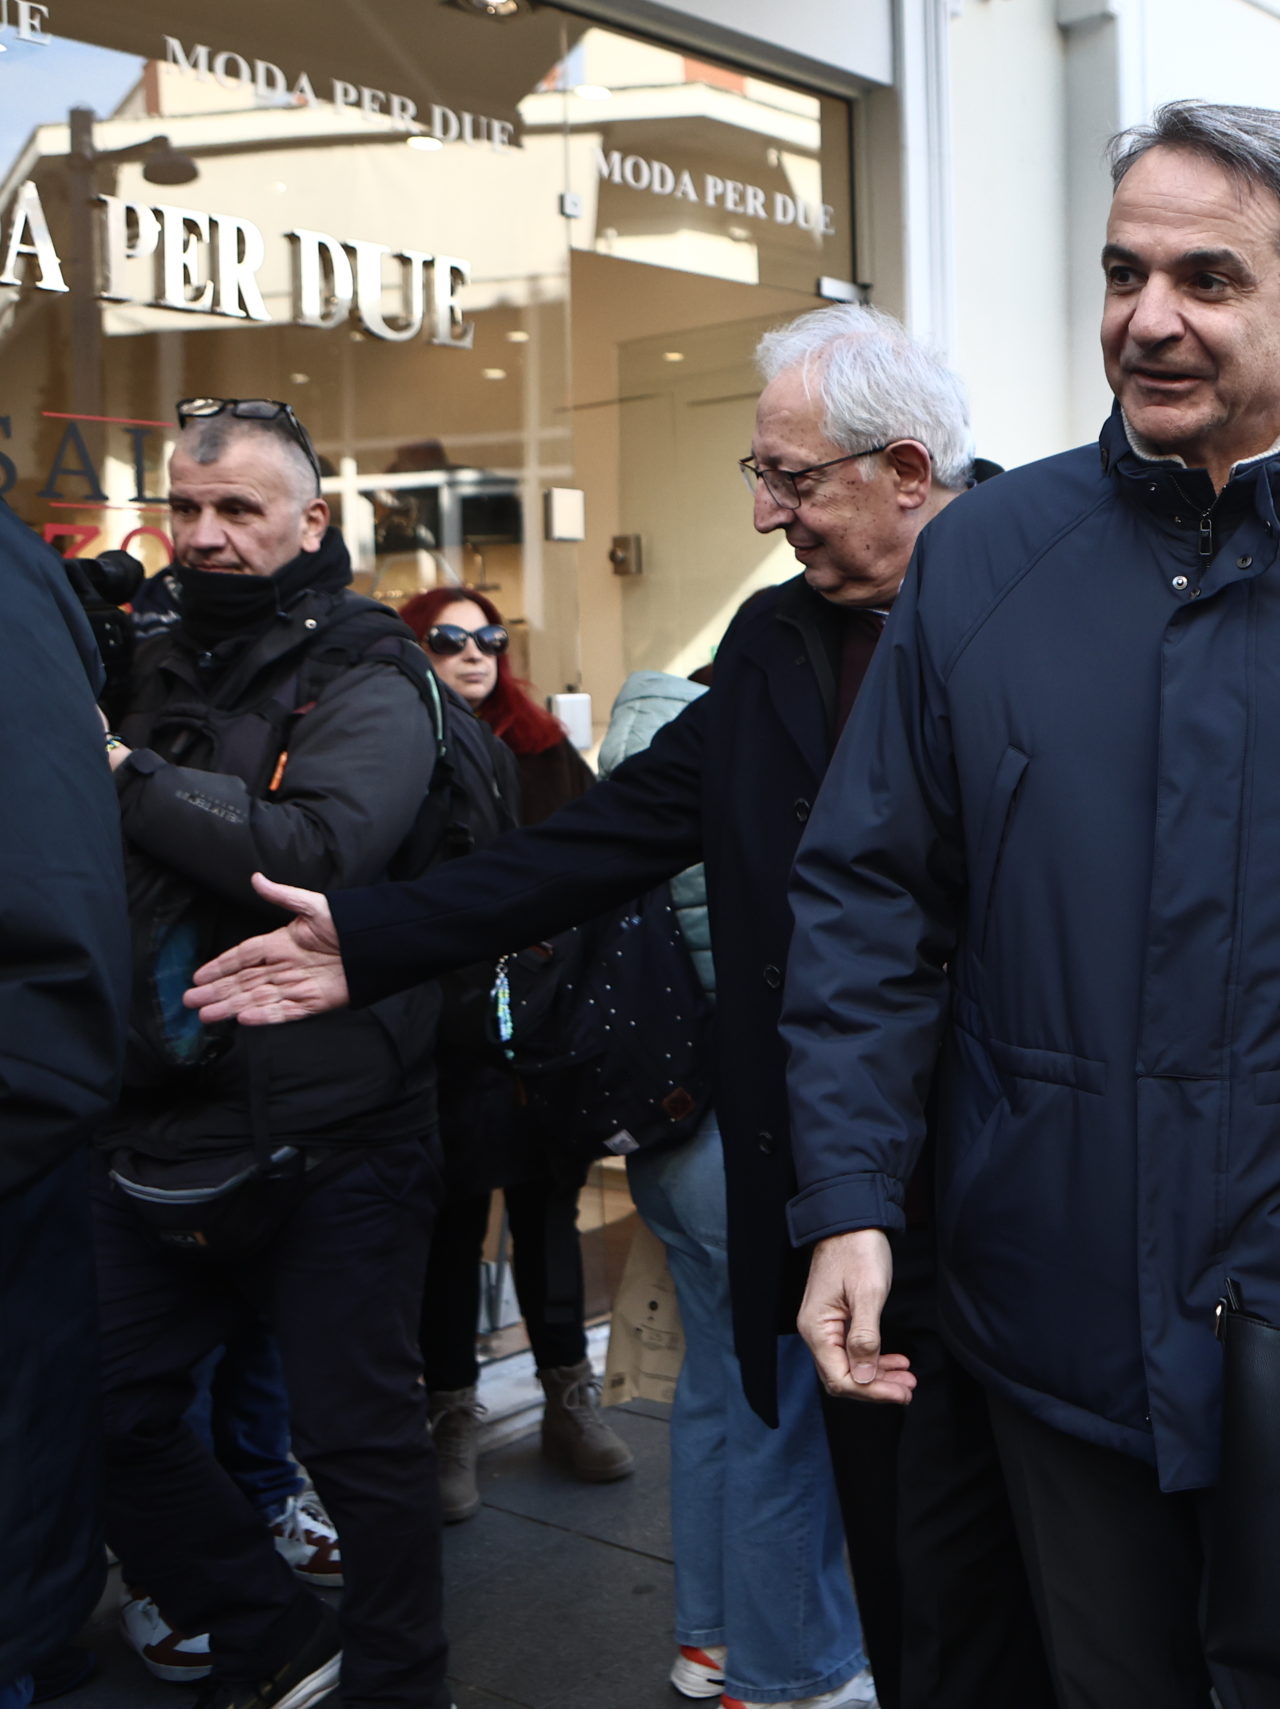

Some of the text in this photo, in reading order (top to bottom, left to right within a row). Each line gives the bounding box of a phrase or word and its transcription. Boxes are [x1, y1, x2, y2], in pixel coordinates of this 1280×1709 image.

[0, 0, 51, 46] E
[163, 34, 517, 152] MODA PER DUE
[594, 147, 836, 236] MODA PER DUE
[97, 194, 272, 322] PER
[283, 228, 475, 349] DUE
